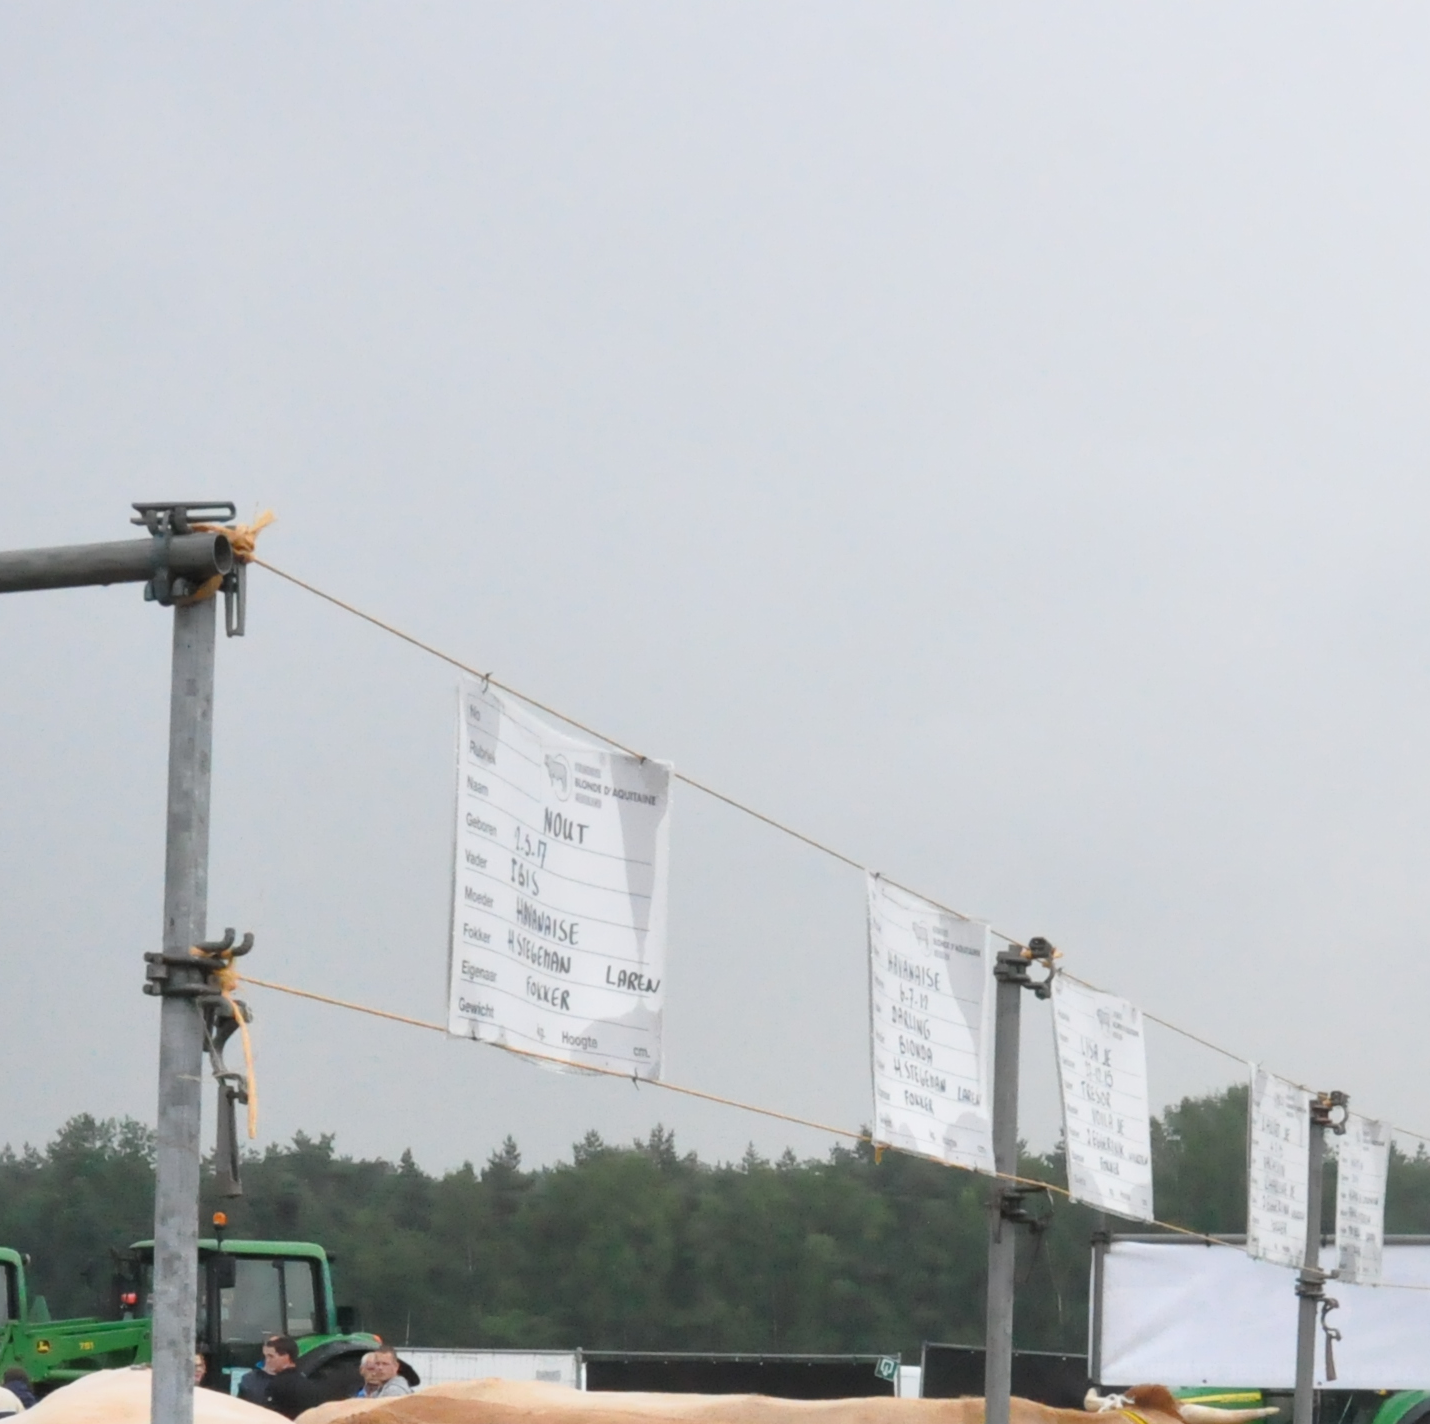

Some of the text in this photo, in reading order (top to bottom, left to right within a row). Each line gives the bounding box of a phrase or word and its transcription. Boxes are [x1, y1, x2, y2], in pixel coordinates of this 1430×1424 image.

[466, 812, 497, 837] Geboren
[544, 807, 589, 844] NOUT
[465, 849, 488, 869] Vader
[464, 886, 494, 909] Moeder
[461, 960, 498, 982] Eigenaar
[463, 923, 492, 944] Fokker
[605, 965, 661, 994] LAREN
[458, 998, 495, 1019] Gewicht
[561, 1031, 598, 1051] Hoogte
